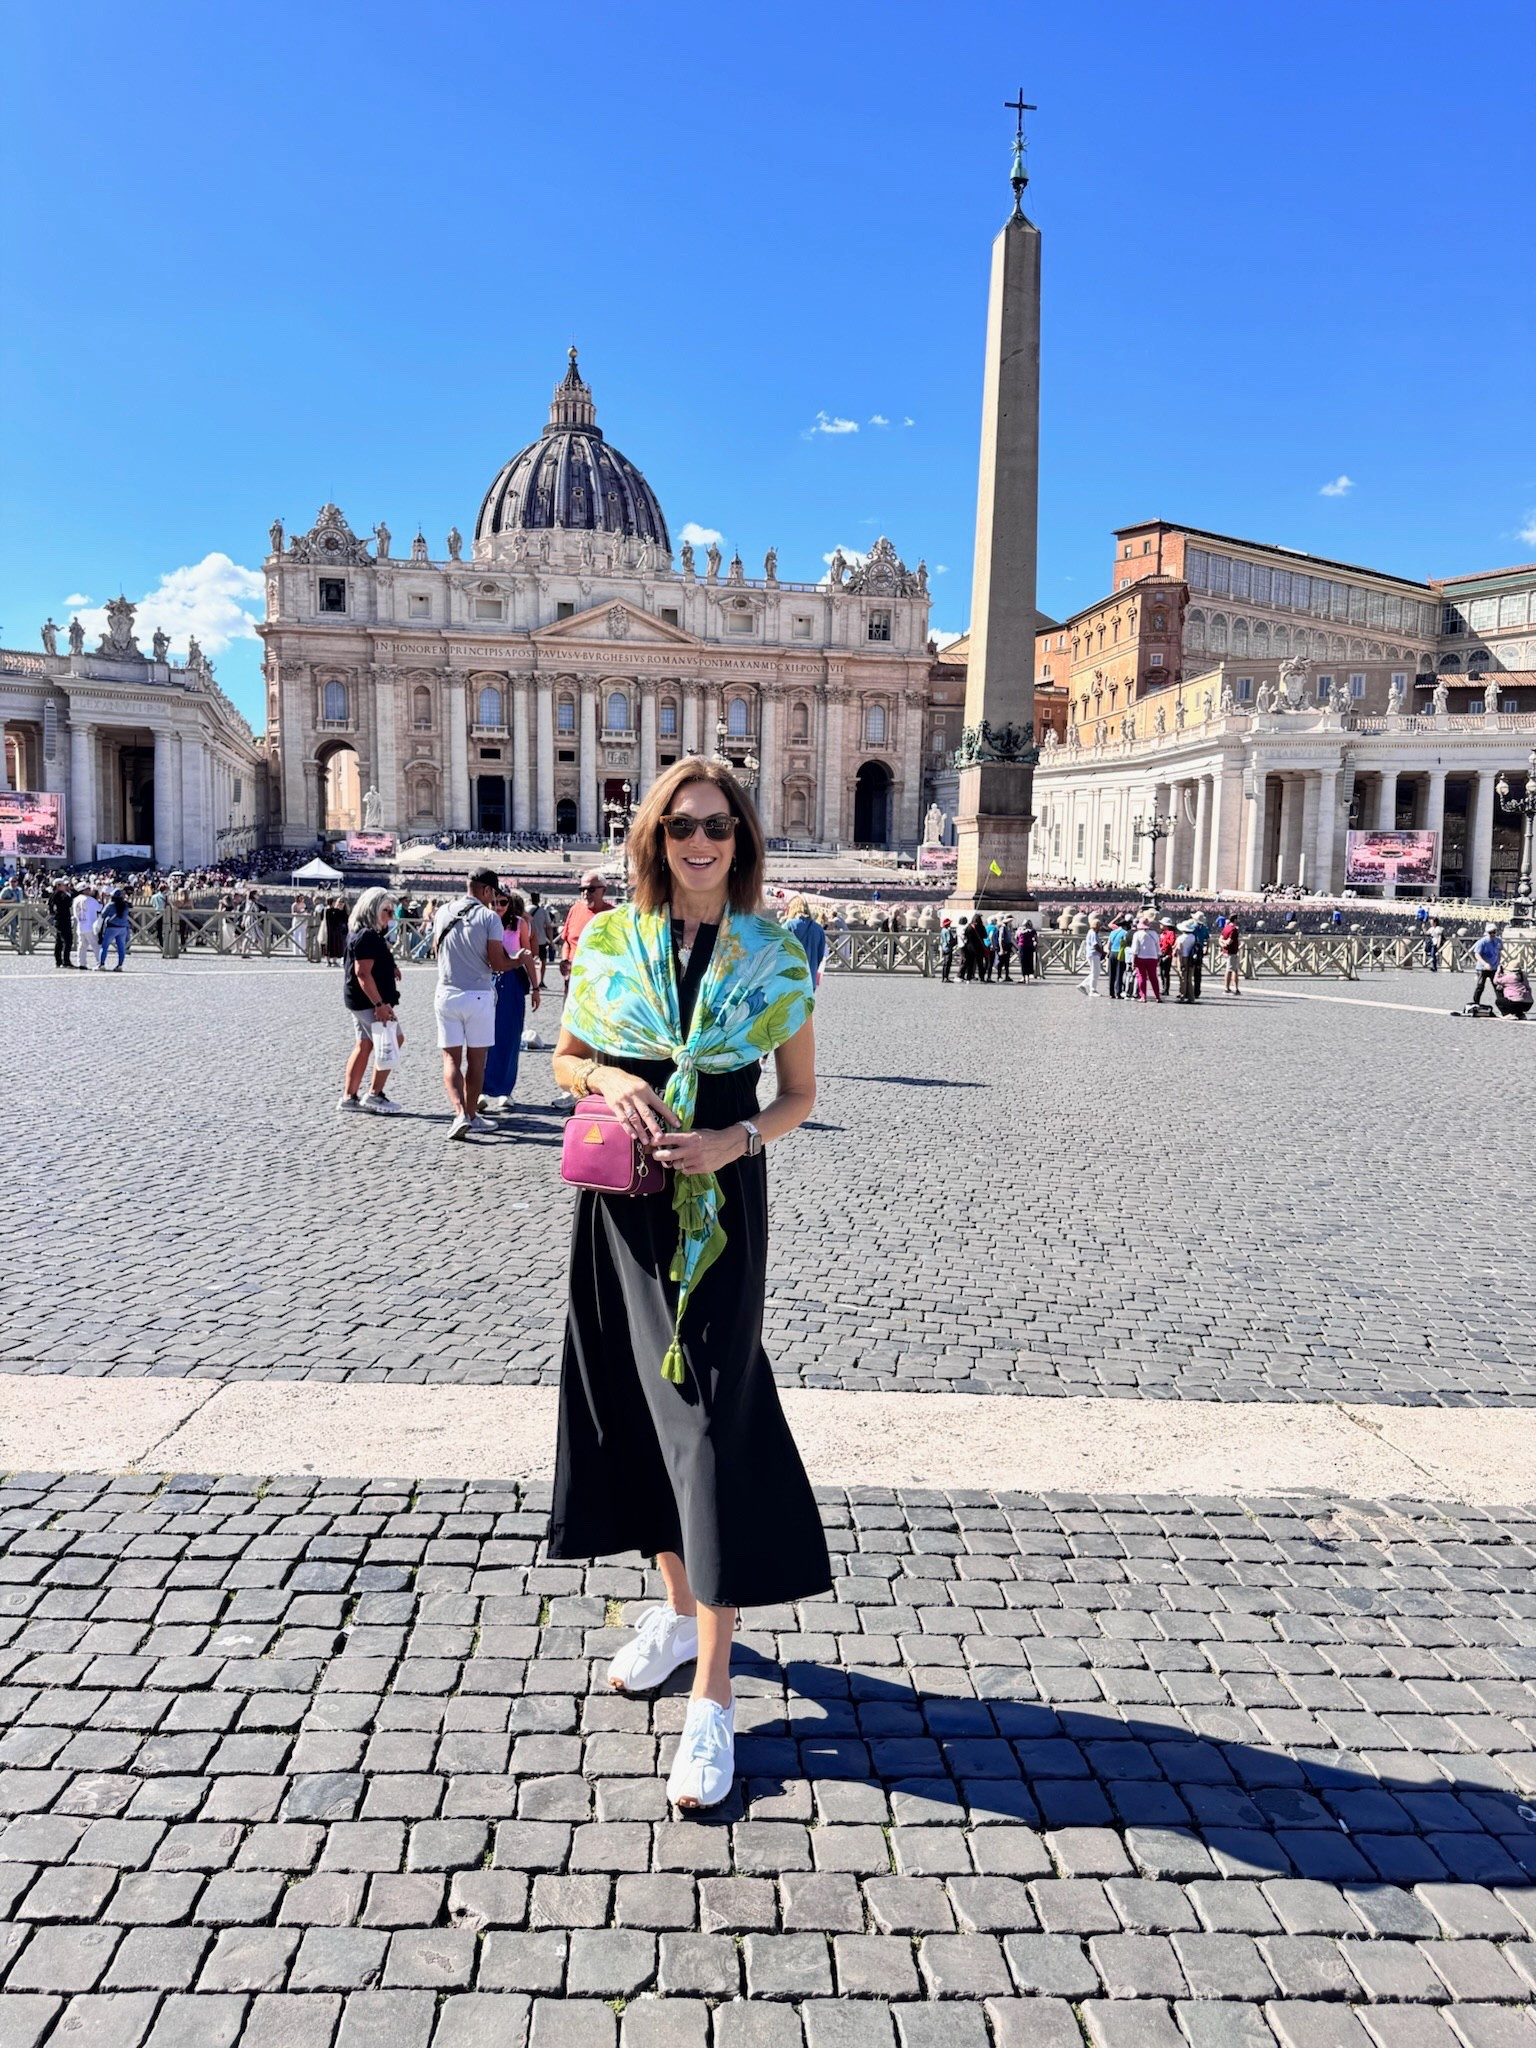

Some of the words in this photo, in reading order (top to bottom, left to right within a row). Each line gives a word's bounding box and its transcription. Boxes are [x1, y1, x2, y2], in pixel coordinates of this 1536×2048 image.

[375, 641, 389, 650] IN
[392, 643, 447, 655] HONOREM
[450, 645, 502, 657] PRINCIPIS
[538, 650, 572, 659] PAVLVS
[583, 652, 645, 663] BVRGHESIVS
[647, 655, 698, 666] ROMANVS
[830, 664, 844, 673] VII
